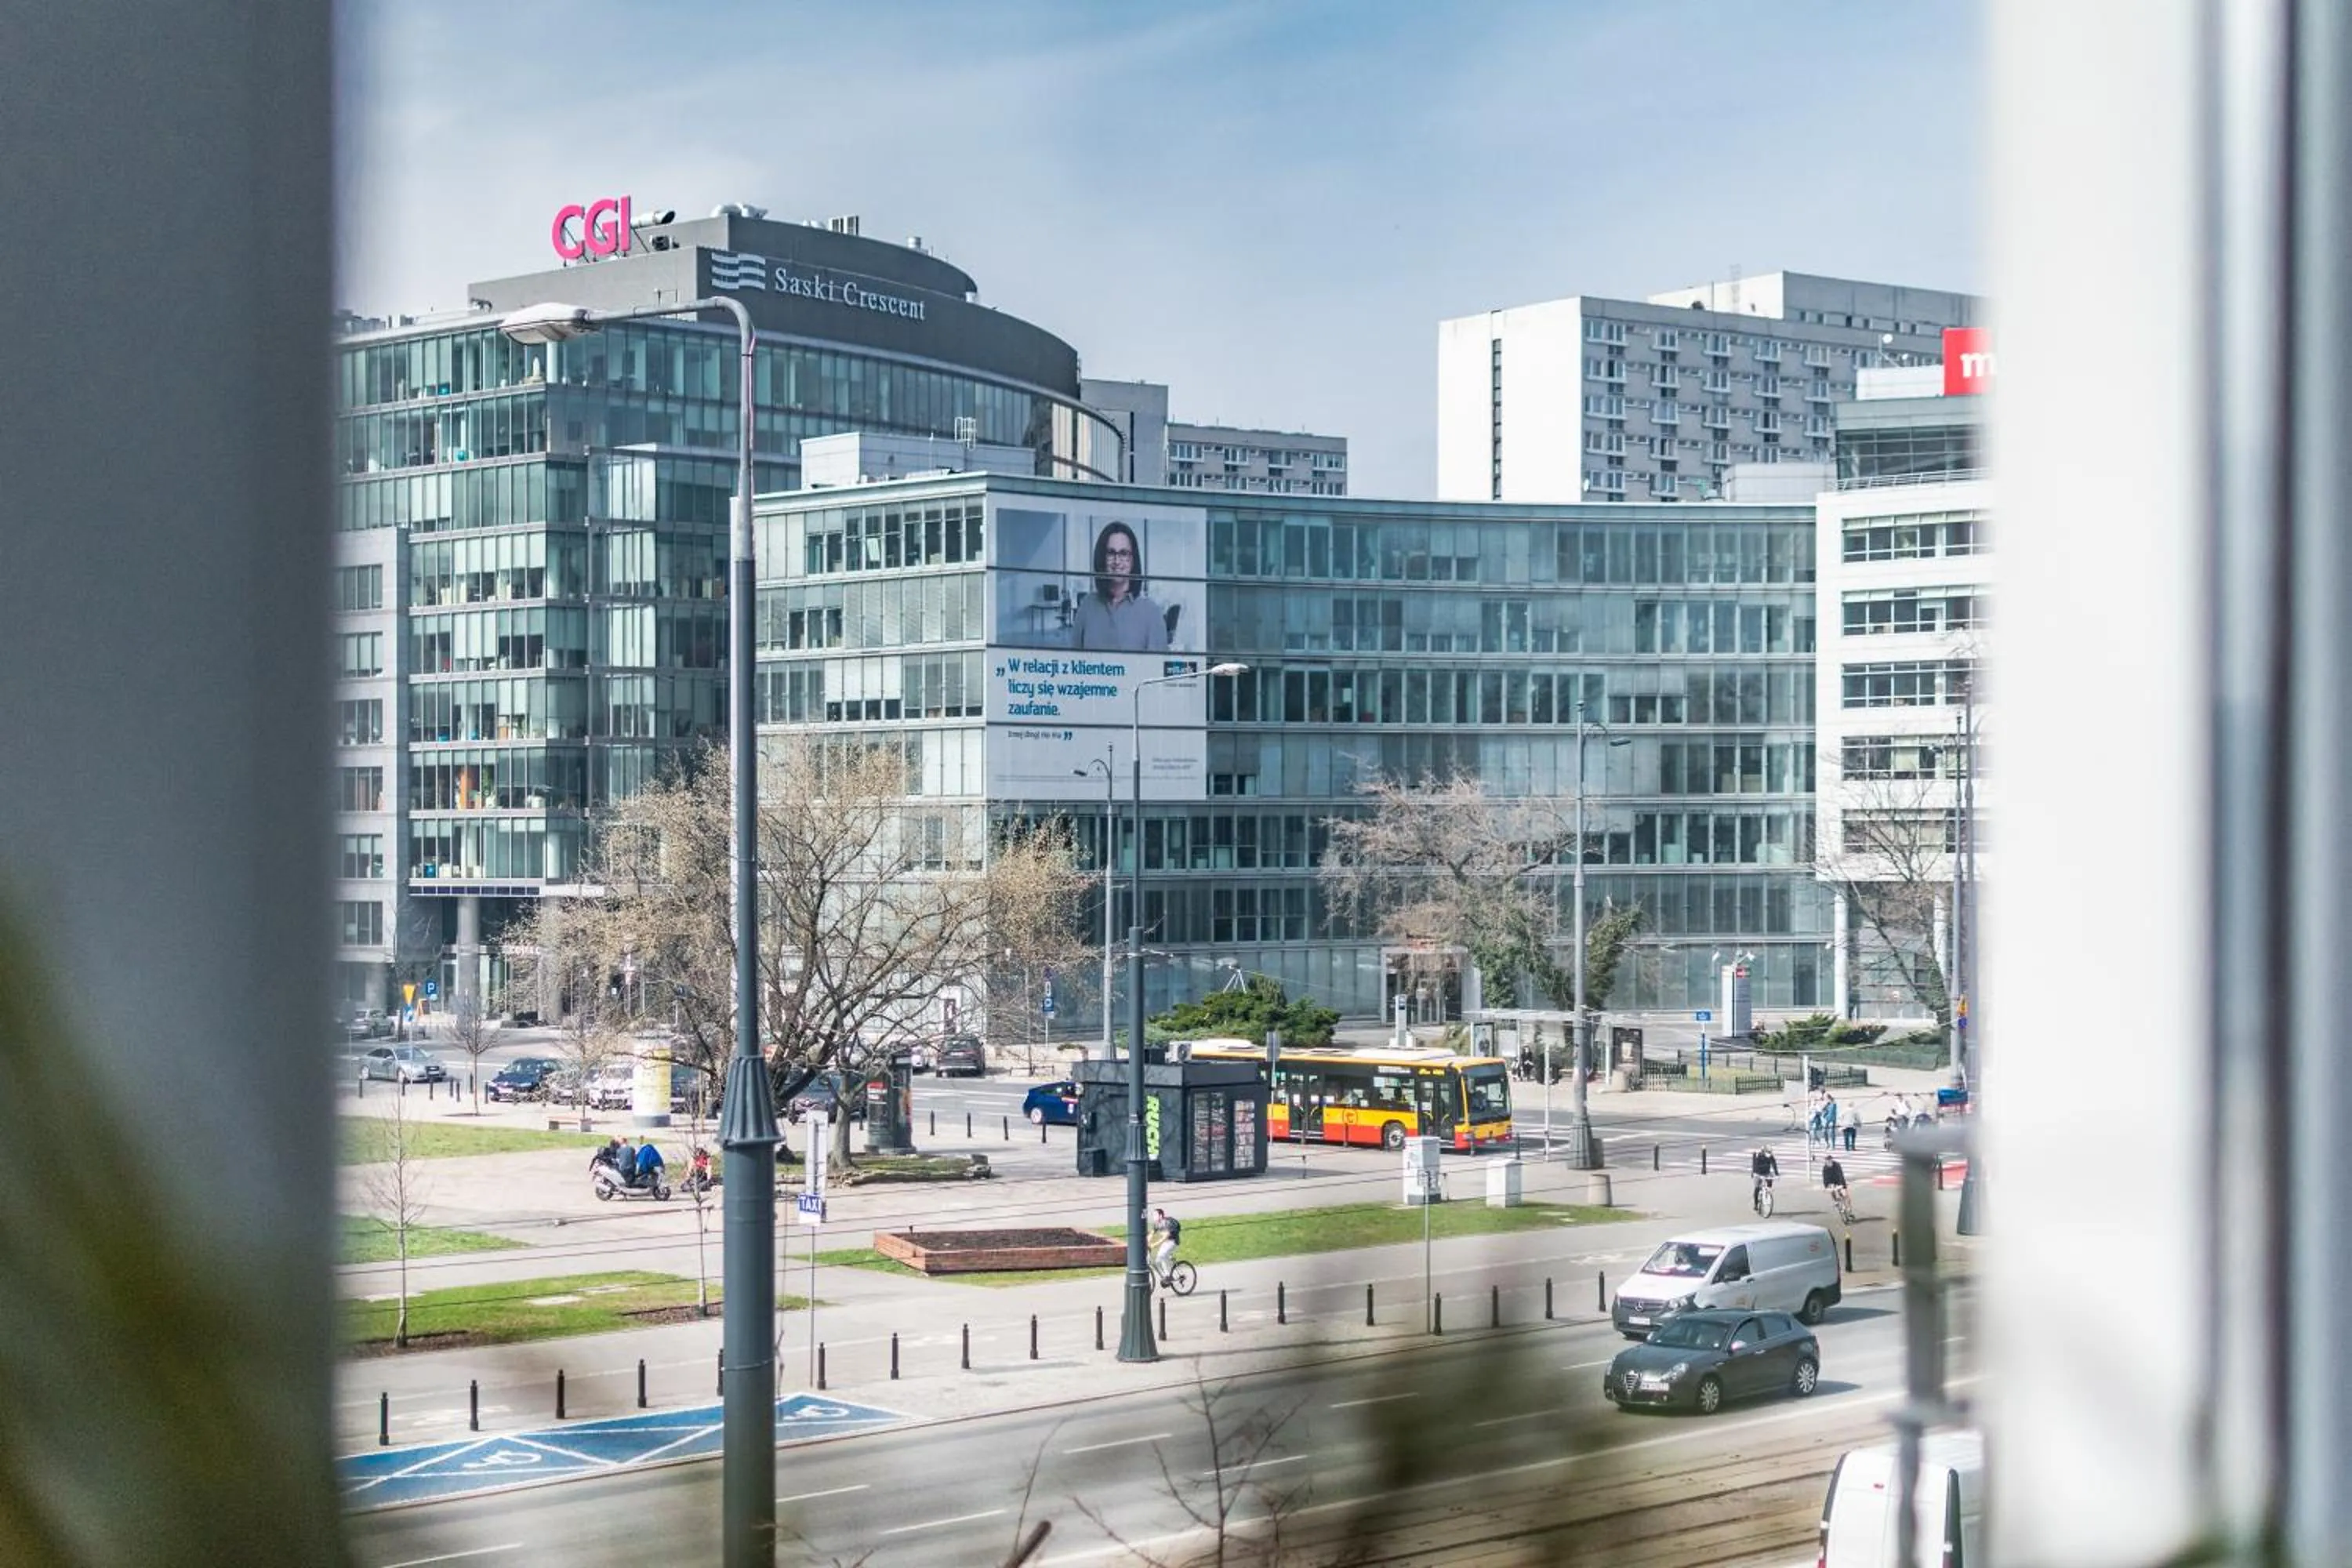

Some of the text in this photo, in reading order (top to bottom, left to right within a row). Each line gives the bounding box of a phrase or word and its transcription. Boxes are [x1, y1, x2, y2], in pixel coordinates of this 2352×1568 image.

[551, 195, 630, 260] CGI
[775, 267, 925, 320] Saski Crescent
[1007, 658, 1125, 677] W relacji z klientem
[1008, 679, 1117, 699] liczy się wzajemne
[1008, 701, 1061, 716] zaufanie.
[426, 982, 435, 993] P
[800, 1196, 822, 1212] TAXI
